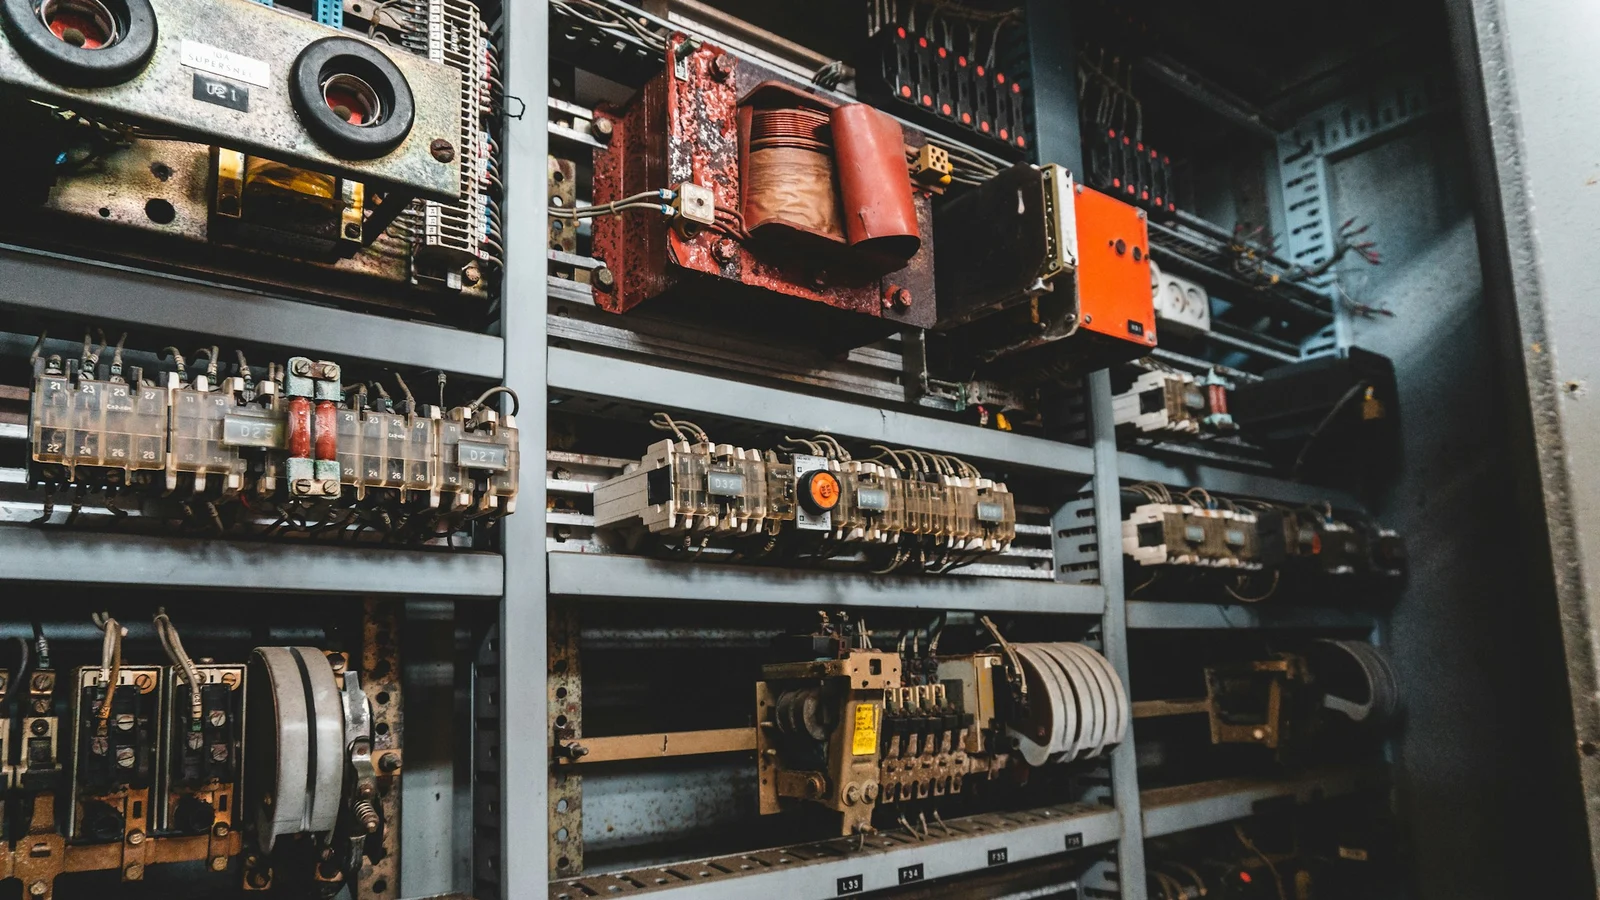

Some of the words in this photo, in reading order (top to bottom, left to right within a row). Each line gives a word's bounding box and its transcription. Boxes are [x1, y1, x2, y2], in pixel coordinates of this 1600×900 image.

[51, 382, 61, 390] 21
[83, 385, 95, 393] 23
[114, 388, 125, 396] 25
[145, 391, 155, 400] 27
[345, 413, 353, 421] 21
[369, 416, 379, 424] 23
[241, 425, 273, 440] D25
[47, 444, 59, 453] 22
[80, 446, 91, 455] 24
[112, 449, 124, 457] 26
[143, 451, 155, 459] 28
[470, 449, 495, 462] D27
[344, 468, 354, 476] 22
[392, 472, 401, 480] 26
[715, 478, 734, 490] D32
[903, 869, 918, 879] F34
[842, 879, 859, 891] L33
